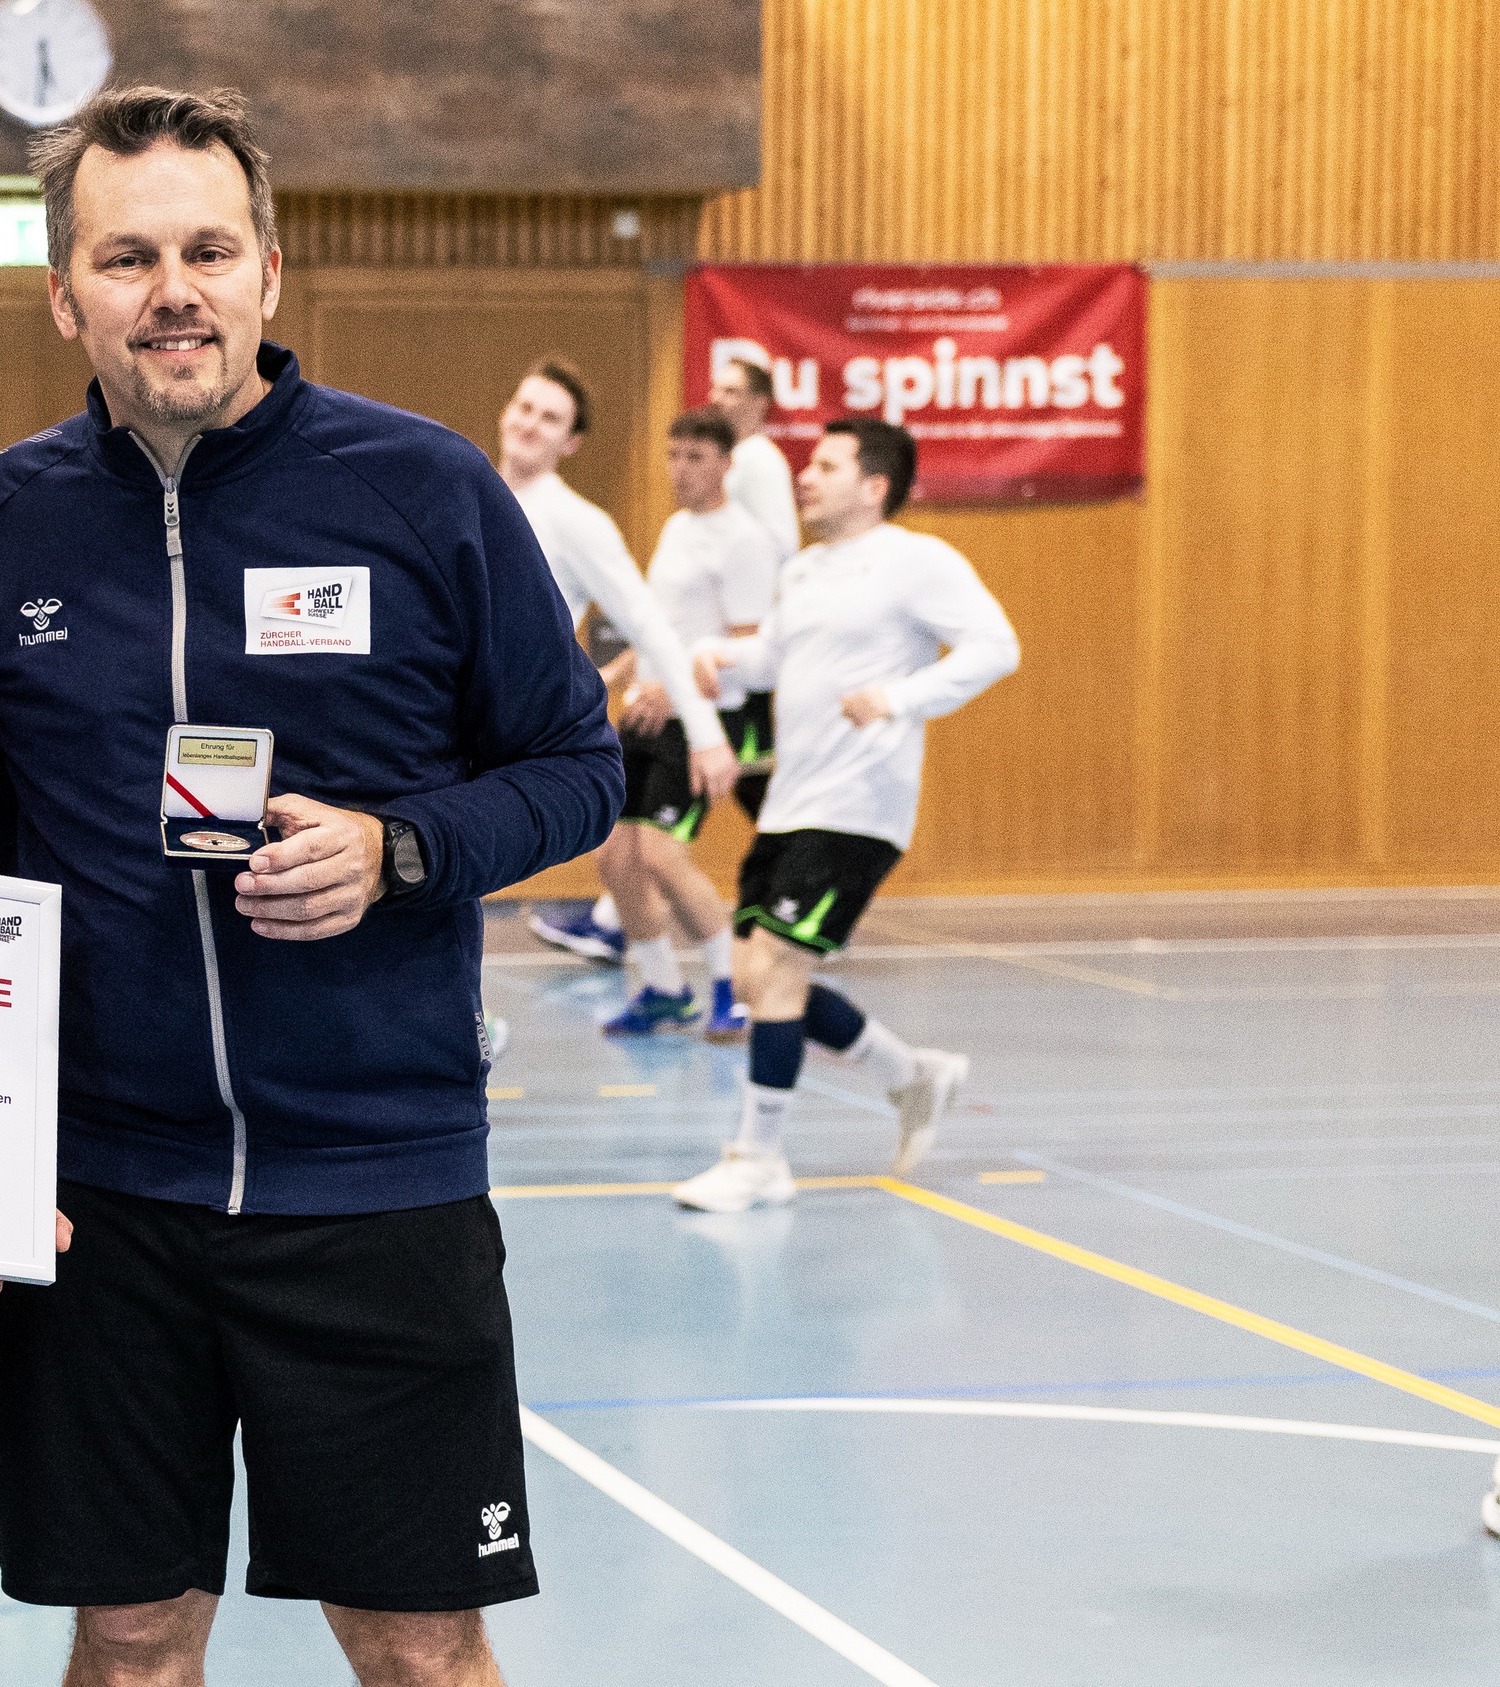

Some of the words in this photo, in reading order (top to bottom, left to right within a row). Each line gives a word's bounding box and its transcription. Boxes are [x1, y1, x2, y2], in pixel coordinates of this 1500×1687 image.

[843, 338, 1124, 425] spinnst
[307, 583, 343, 599] HAND
[313, 597, 343, 609] BALL
[18, 626, 68, 647] hummel
[260, 630, 302, 640] ZÜRCHER
[260, 639, 352, 648] HANDBALL-VERBAND
[200, 742, 225, 751] Ehrung
[0, 925, 23, 937] BALL
[478, 1532, 520, 1558] hummel
